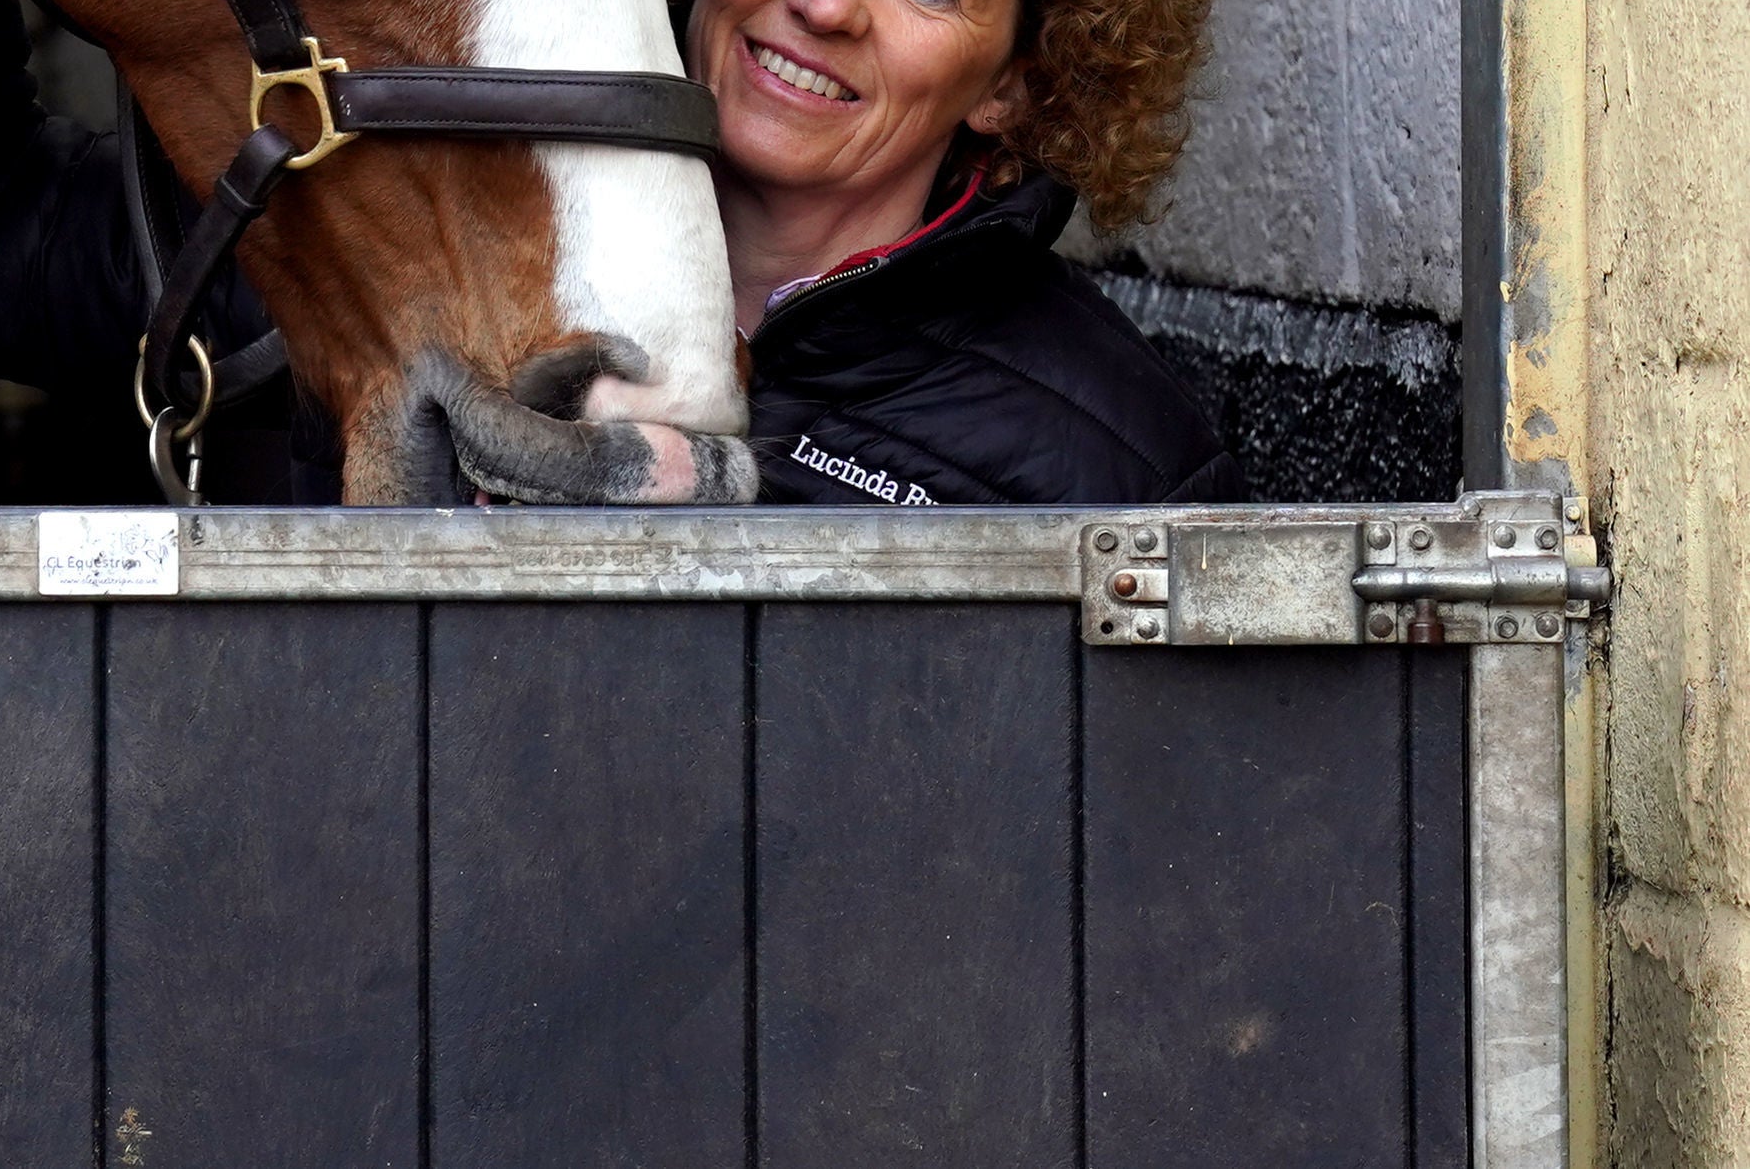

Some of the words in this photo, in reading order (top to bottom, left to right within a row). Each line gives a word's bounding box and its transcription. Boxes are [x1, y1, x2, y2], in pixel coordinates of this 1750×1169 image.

[790, 435, 899, 503] Lucinda
[46, 557, 63, 568] CL
[68, 556, 142, 570] Equestrian
